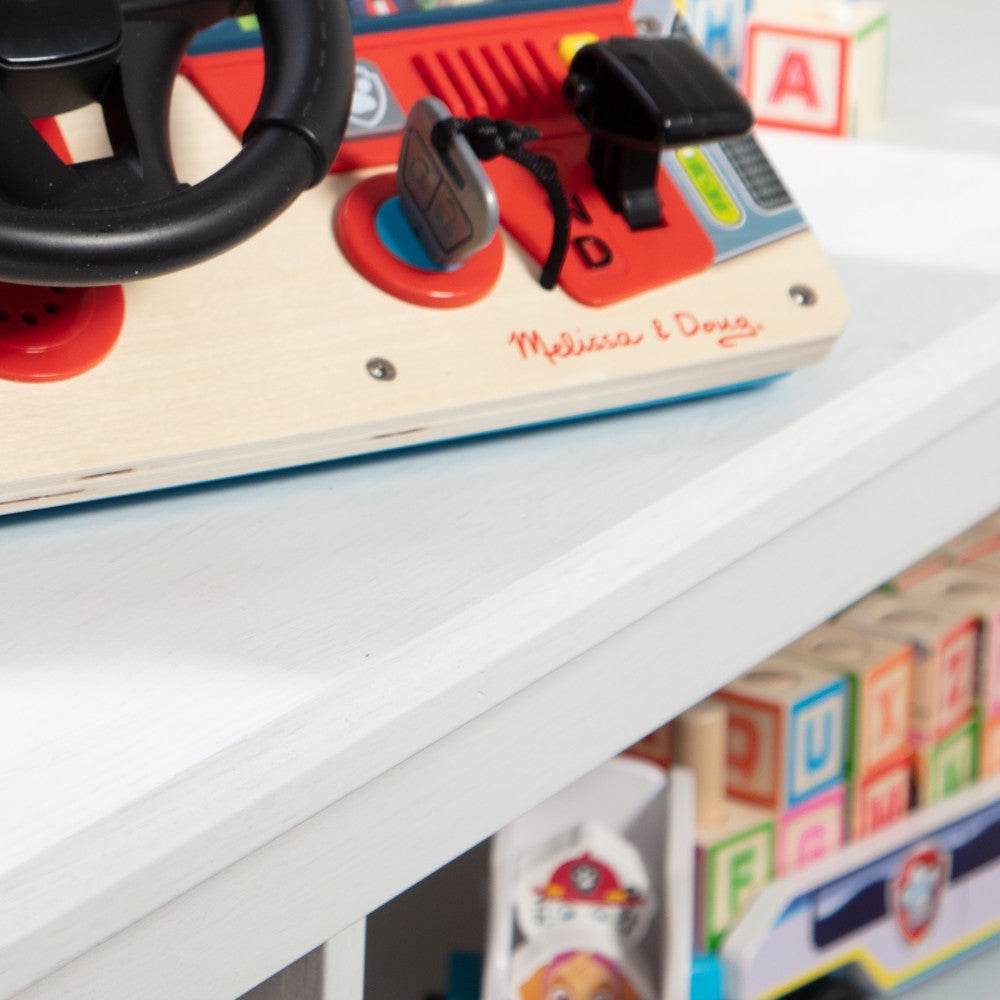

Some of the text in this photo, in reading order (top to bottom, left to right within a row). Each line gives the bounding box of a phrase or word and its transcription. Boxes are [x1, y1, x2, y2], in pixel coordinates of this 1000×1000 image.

[705, 3, 733, 56] H
[768, 48, 821, 109] A
[572, 235, 614, 270] D
[508, 329, 644, 365] Melissa
[803, 710, 835, 774] U
[728, 845, 756, 914] F
